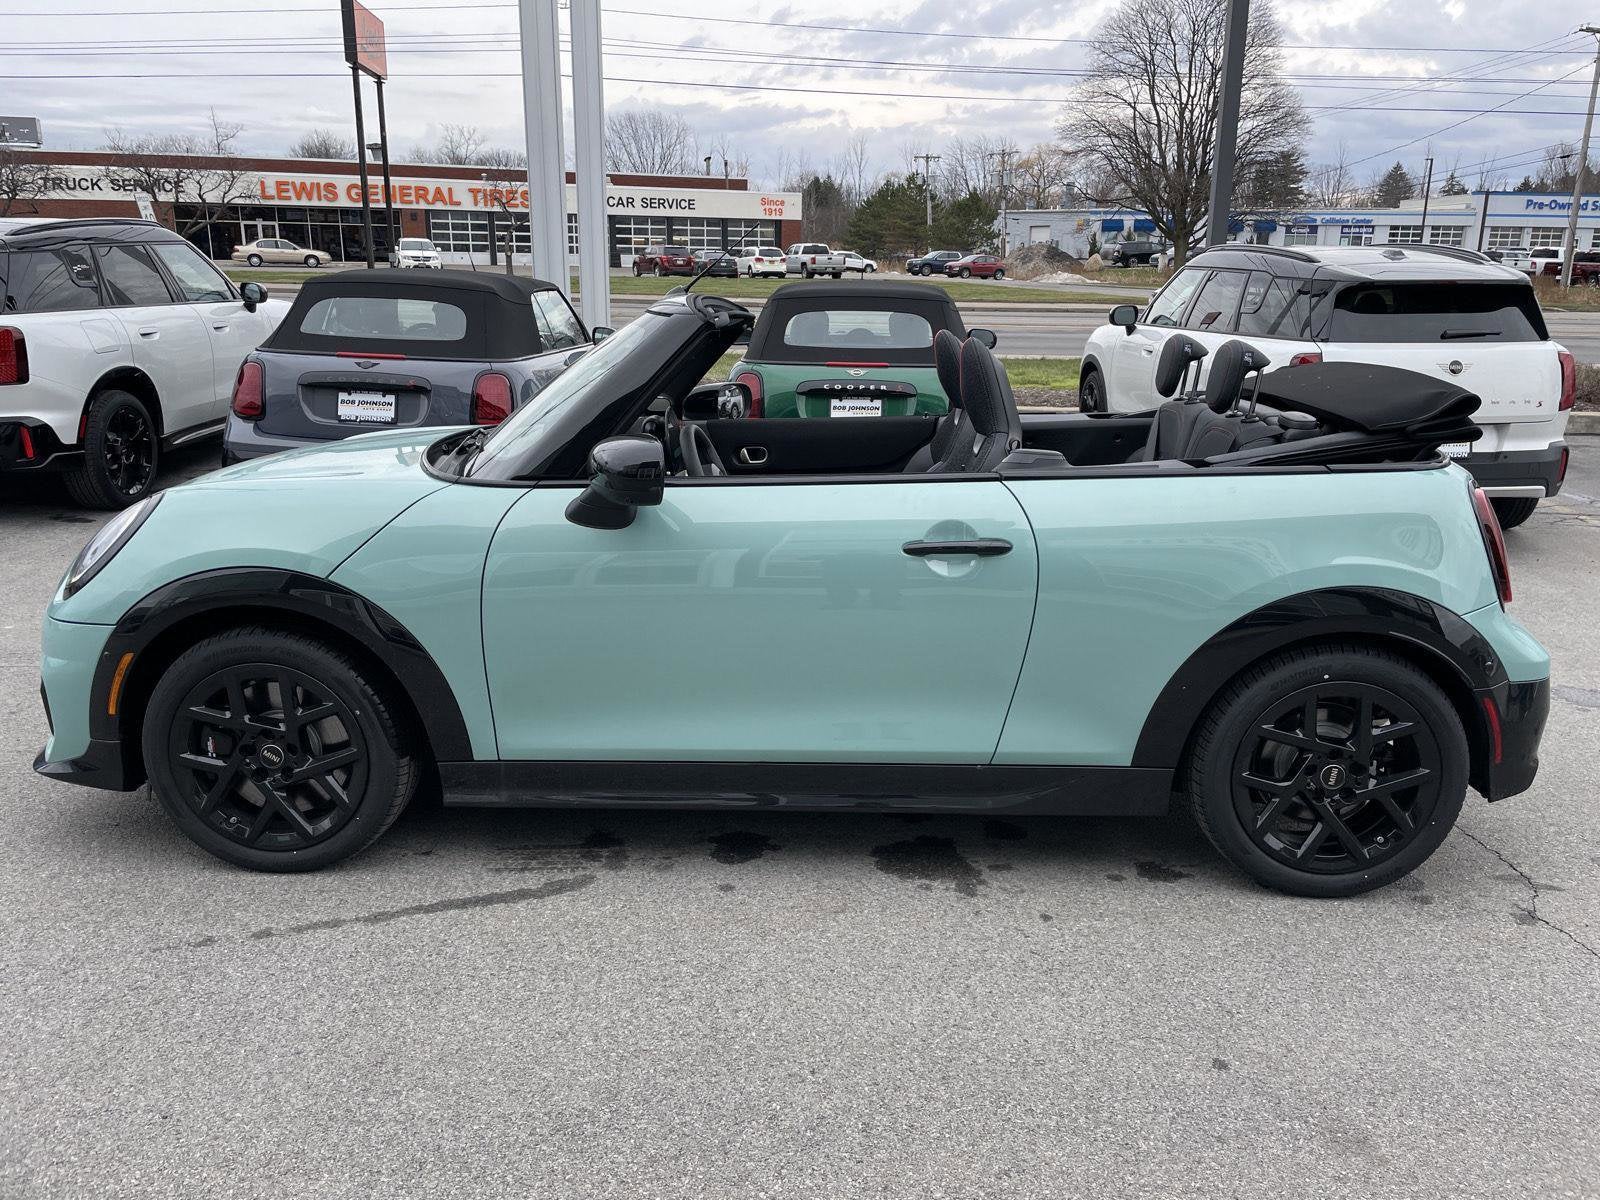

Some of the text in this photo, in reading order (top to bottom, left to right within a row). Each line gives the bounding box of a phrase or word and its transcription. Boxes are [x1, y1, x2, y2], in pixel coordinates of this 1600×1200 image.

[39, 177, 103, 191] TRUCK
[260, 179, 529, 208] LEWIS GENERAL TIRES
[606, 196, 696, 210] CAR SERVICE
[760, 197, 785, 207] Since
[1525, 199, 1600, 211] Pre-Ownd S
[763, 208, 783, 217] 1919
[263, 750, 280, 763] MINI
[1328, 768, 1339, 785] MINI
